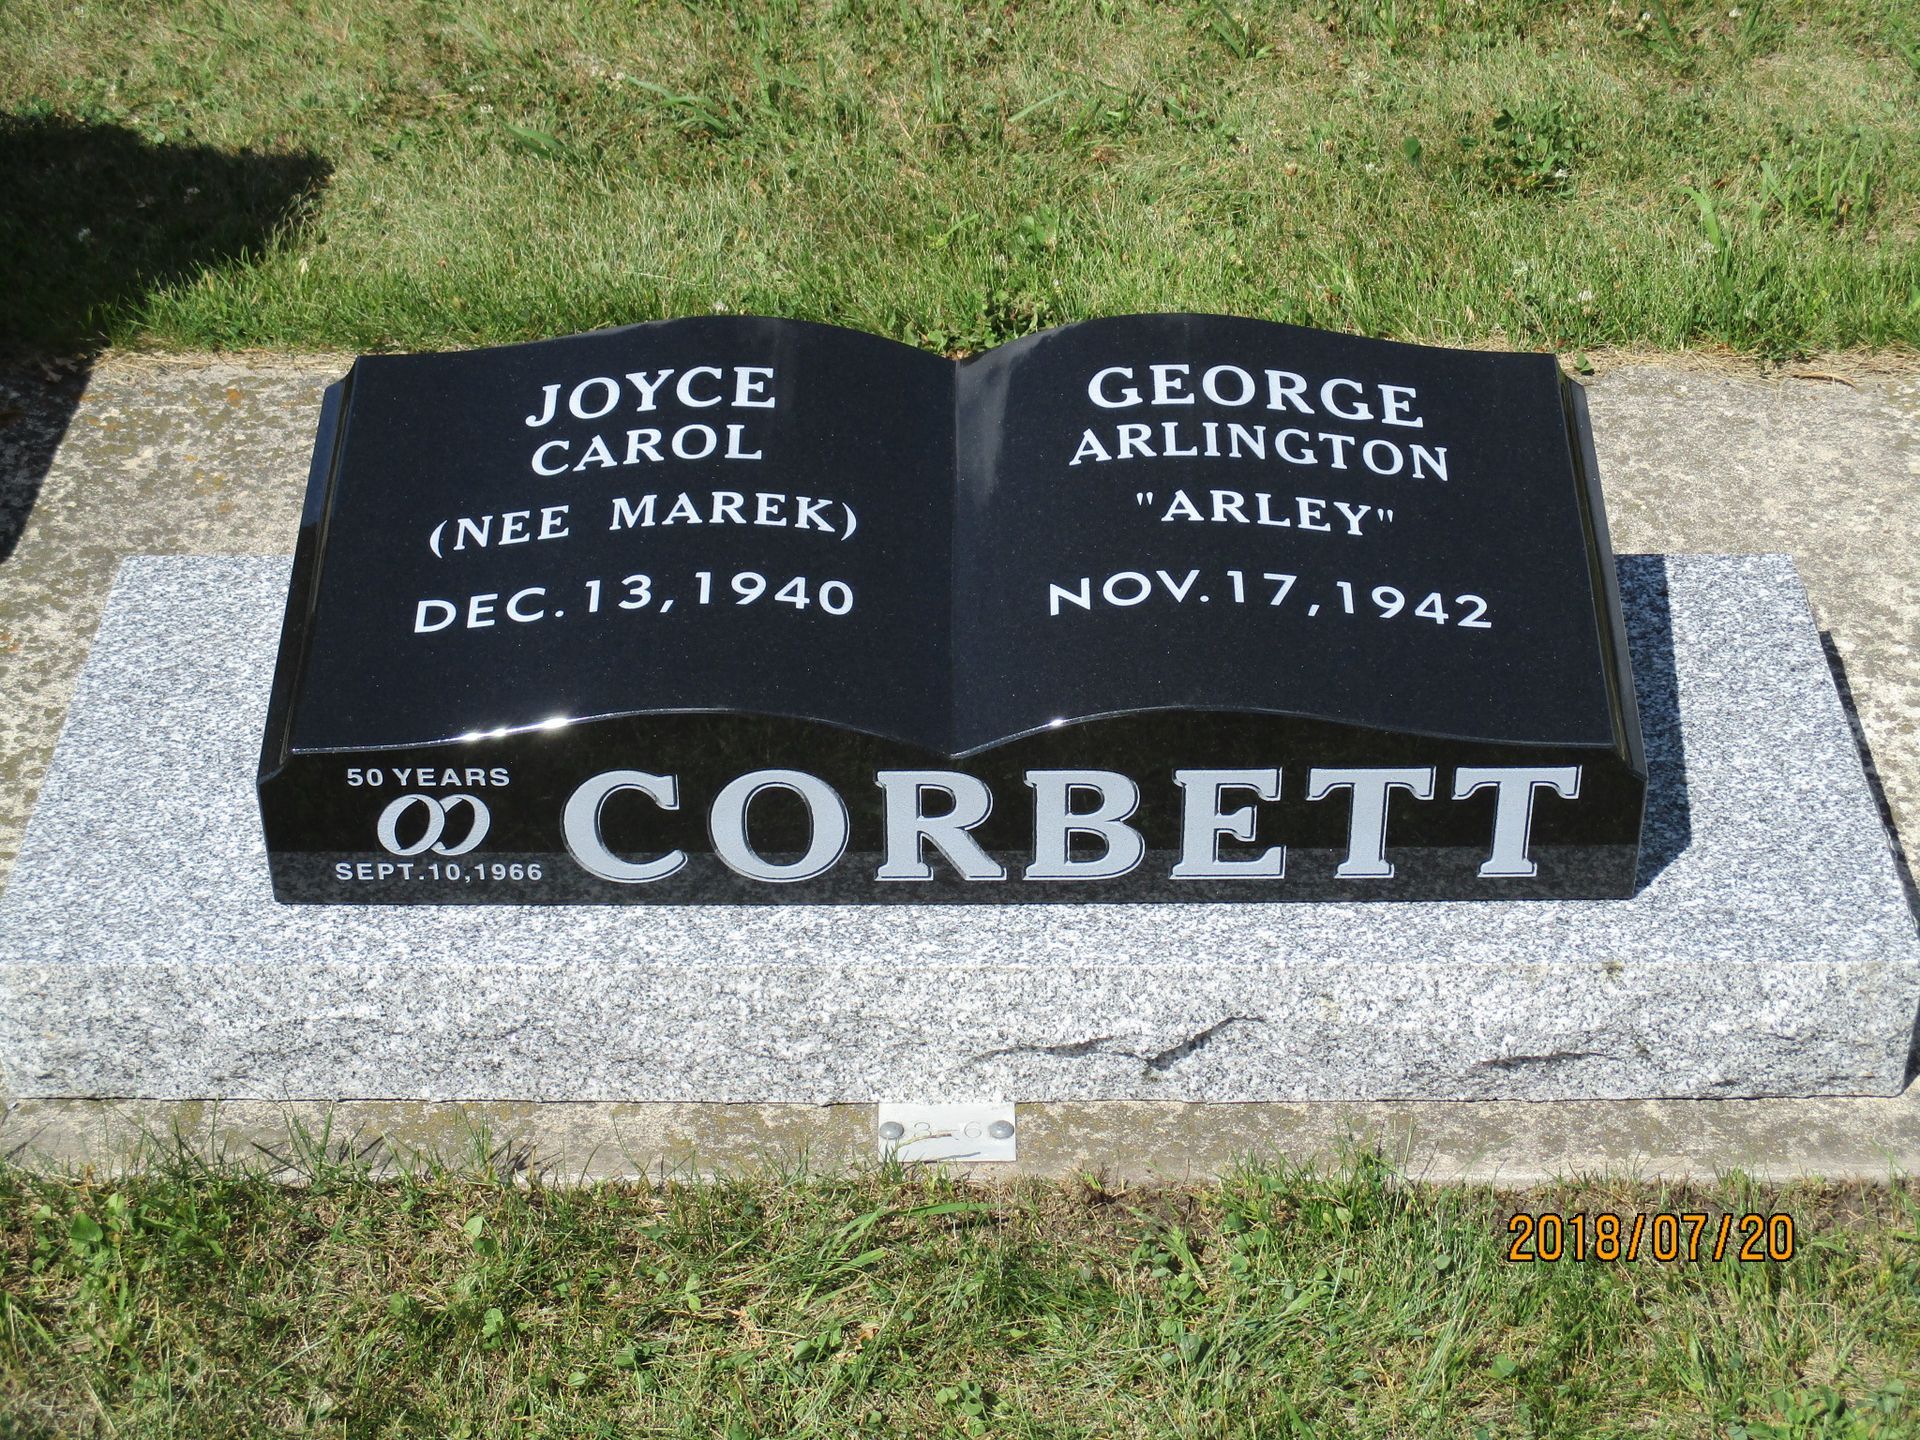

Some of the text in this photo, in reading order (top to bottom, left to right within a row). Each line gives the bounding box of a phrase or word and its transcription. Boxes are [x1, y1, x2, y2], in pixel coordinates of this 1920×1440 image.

[525, 366, 776, 428] JOYCE
[1087, 363, 1424, 428] GEORGE
[531, 423, 762, 476] CAROL
[1068, 421, 1448, 482] ARLINGTON
[429, 491, 857, 559] (NEE MAREK)
[1136, 489, 1394, 536] "ARLEY"
[347, 767, 510, 787] 50 YEARS
[561, 766, 1584, 884] CORBETT
